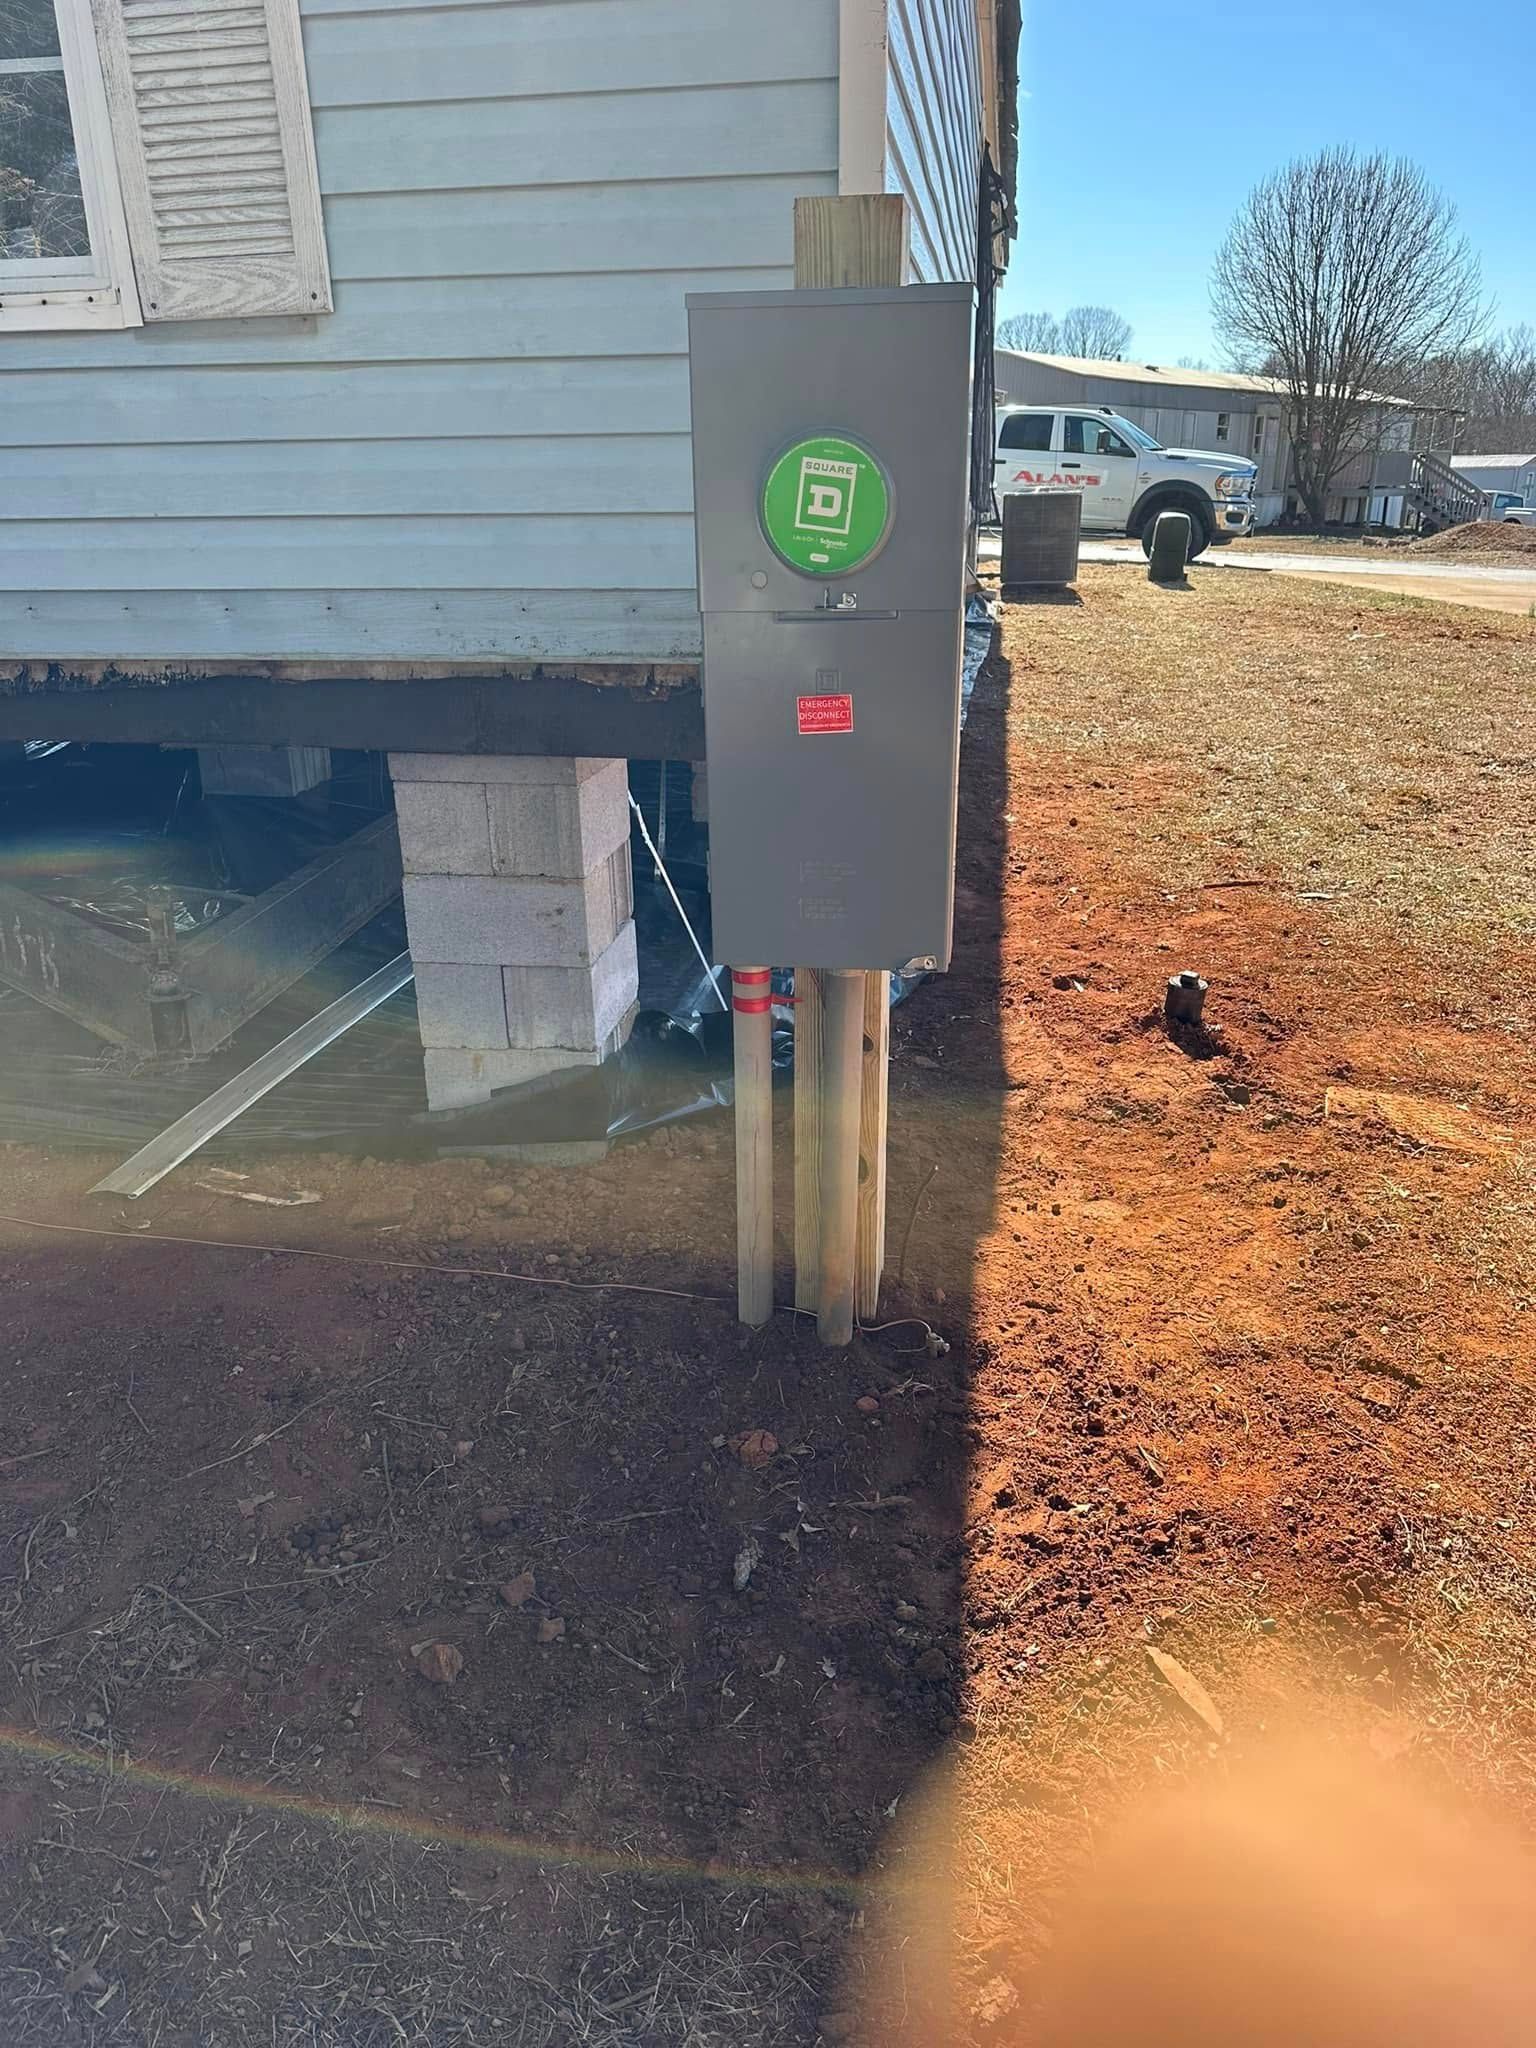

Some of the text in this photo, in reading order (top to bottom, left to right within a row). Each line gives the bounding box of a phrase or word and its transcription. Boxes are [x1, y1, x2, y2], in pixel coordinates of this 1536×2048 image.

[806, 461, 853, 475] SQUARE
[1011, 470, 1101, 486] ALAN'S
[808, 484, 842, 517] D
[800, 699, 849, 709] EMERGENCY
[799, 710, 850, 720] DISCONNECT
